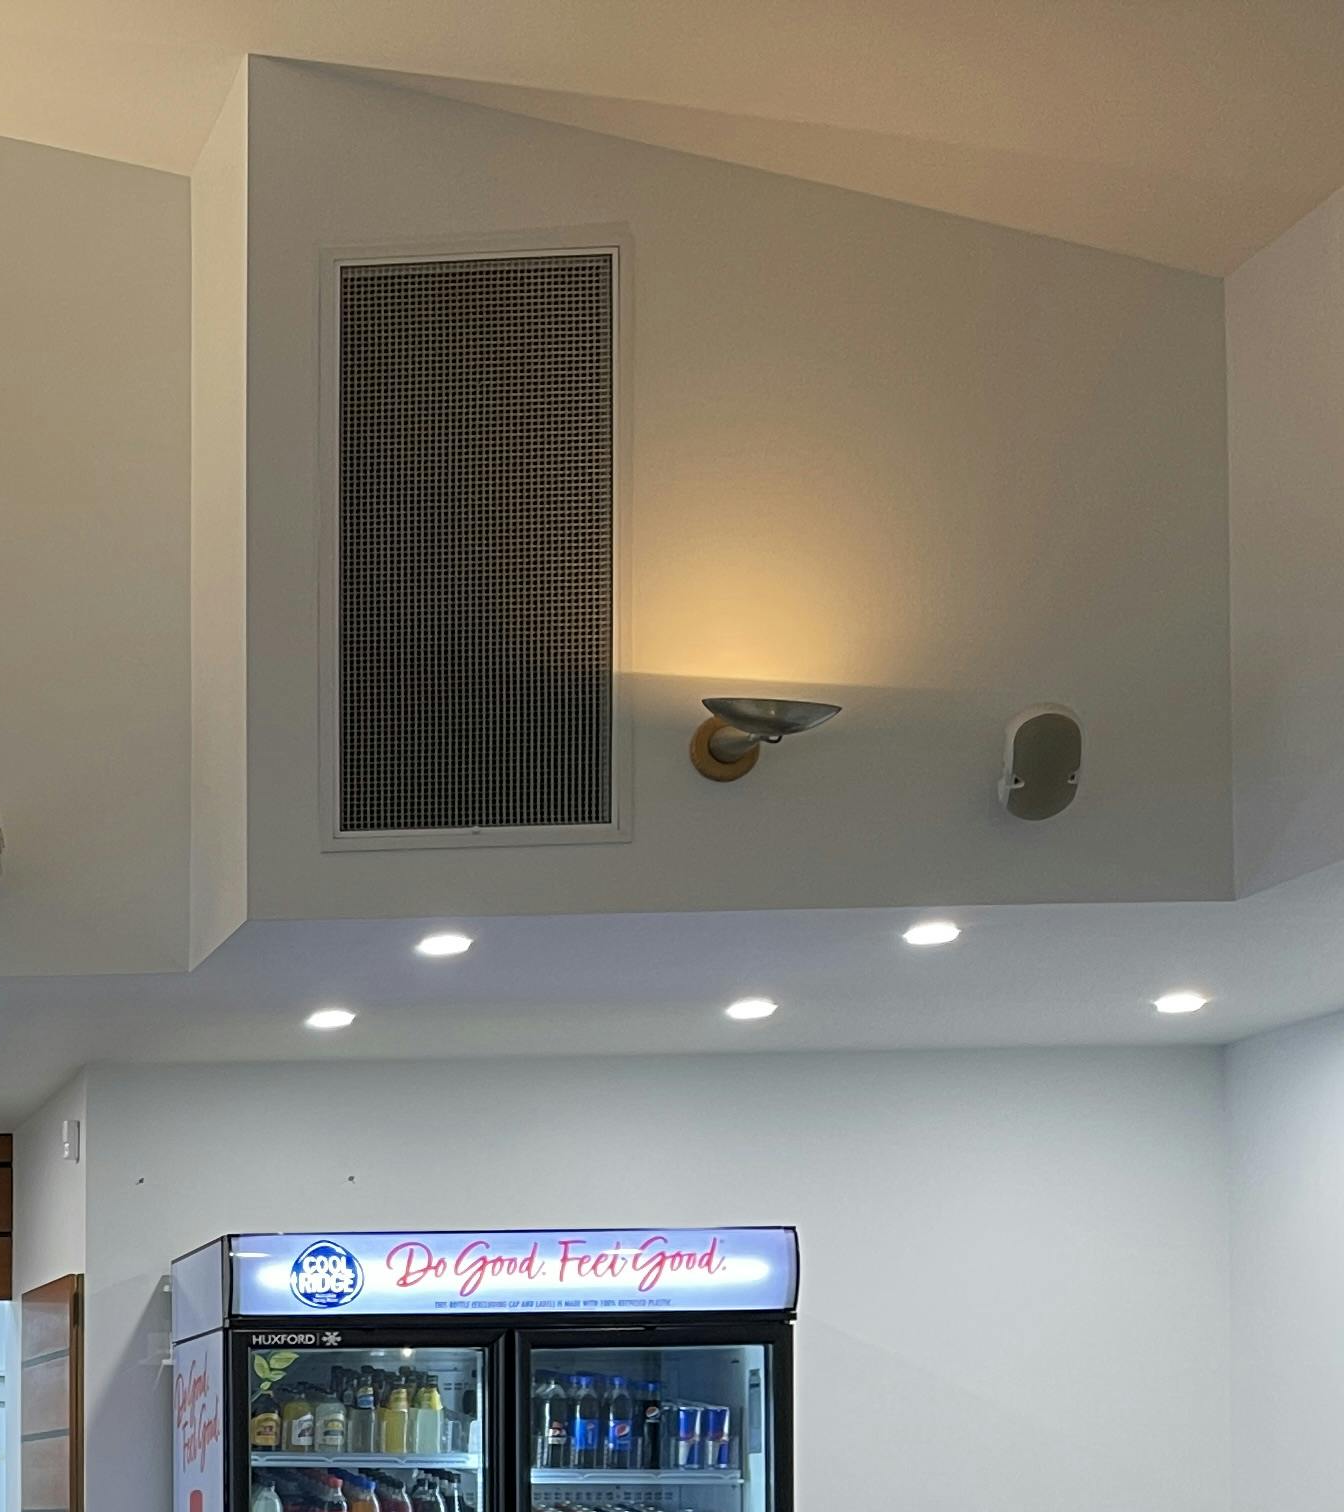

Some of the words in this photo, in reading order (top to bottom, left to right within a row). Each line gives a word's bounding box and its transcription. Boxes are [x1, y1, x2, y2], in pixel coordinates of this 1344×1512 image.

[303, 1255, 355, 1276] COOL
[385, 1240, 448, 1287] Do
[454, 1240, 546, 1297] Good.
[558, 1238, 627, 1283] Feel
[631, 1236, 728, 1293] Good.
[298, 1272, 354, 1294] RIDGE
[252, 1334, 315, 1344] HUXFORD
